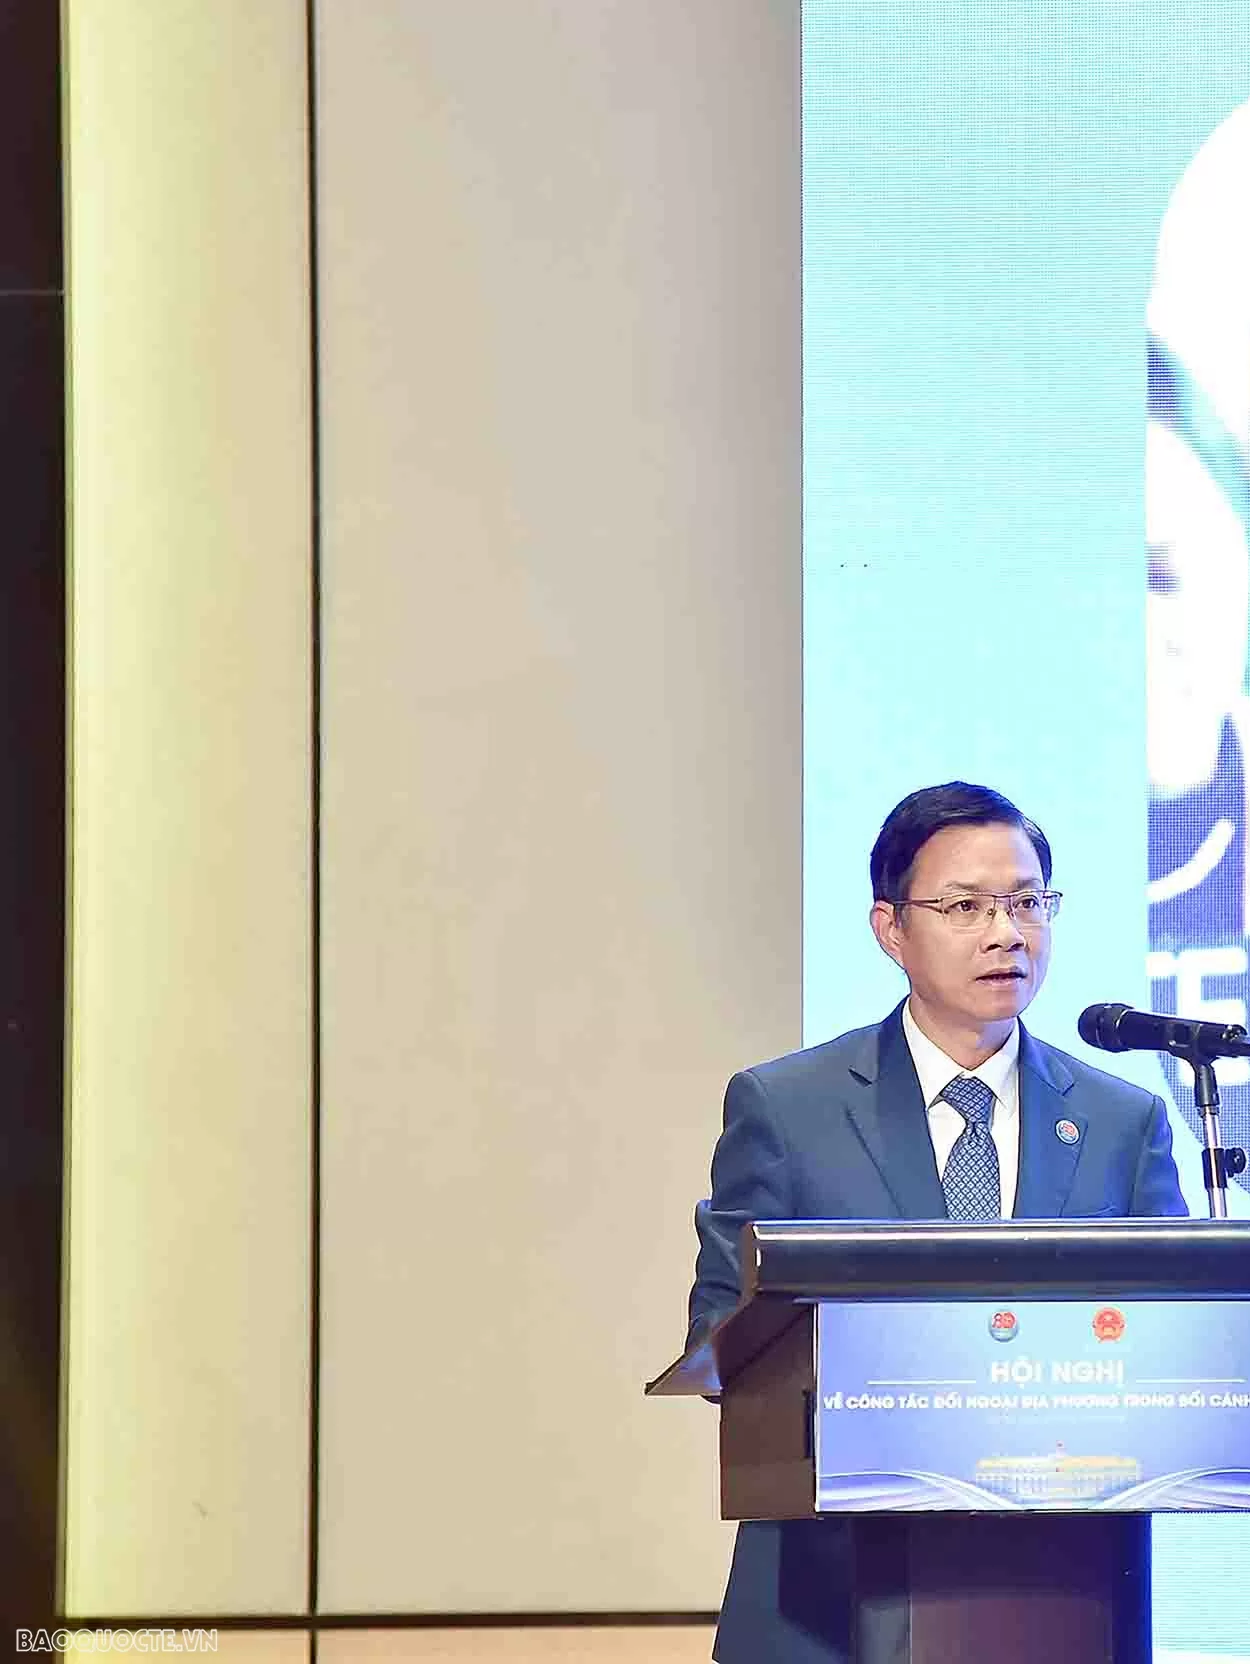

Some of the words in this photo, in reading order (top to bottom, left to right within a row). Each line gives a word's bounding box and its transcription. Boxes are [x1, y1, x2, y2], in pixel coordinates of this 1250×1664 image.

[991, 1355, 1041, 1389] HỘI
[1051, 1359, 1125, 1388] NGHỊ
[823, 1391, 843, 1409] VỀ
[845, 1392, 895, 1409] CÔNG
[898, 1394, 929, 1409] TÁC
